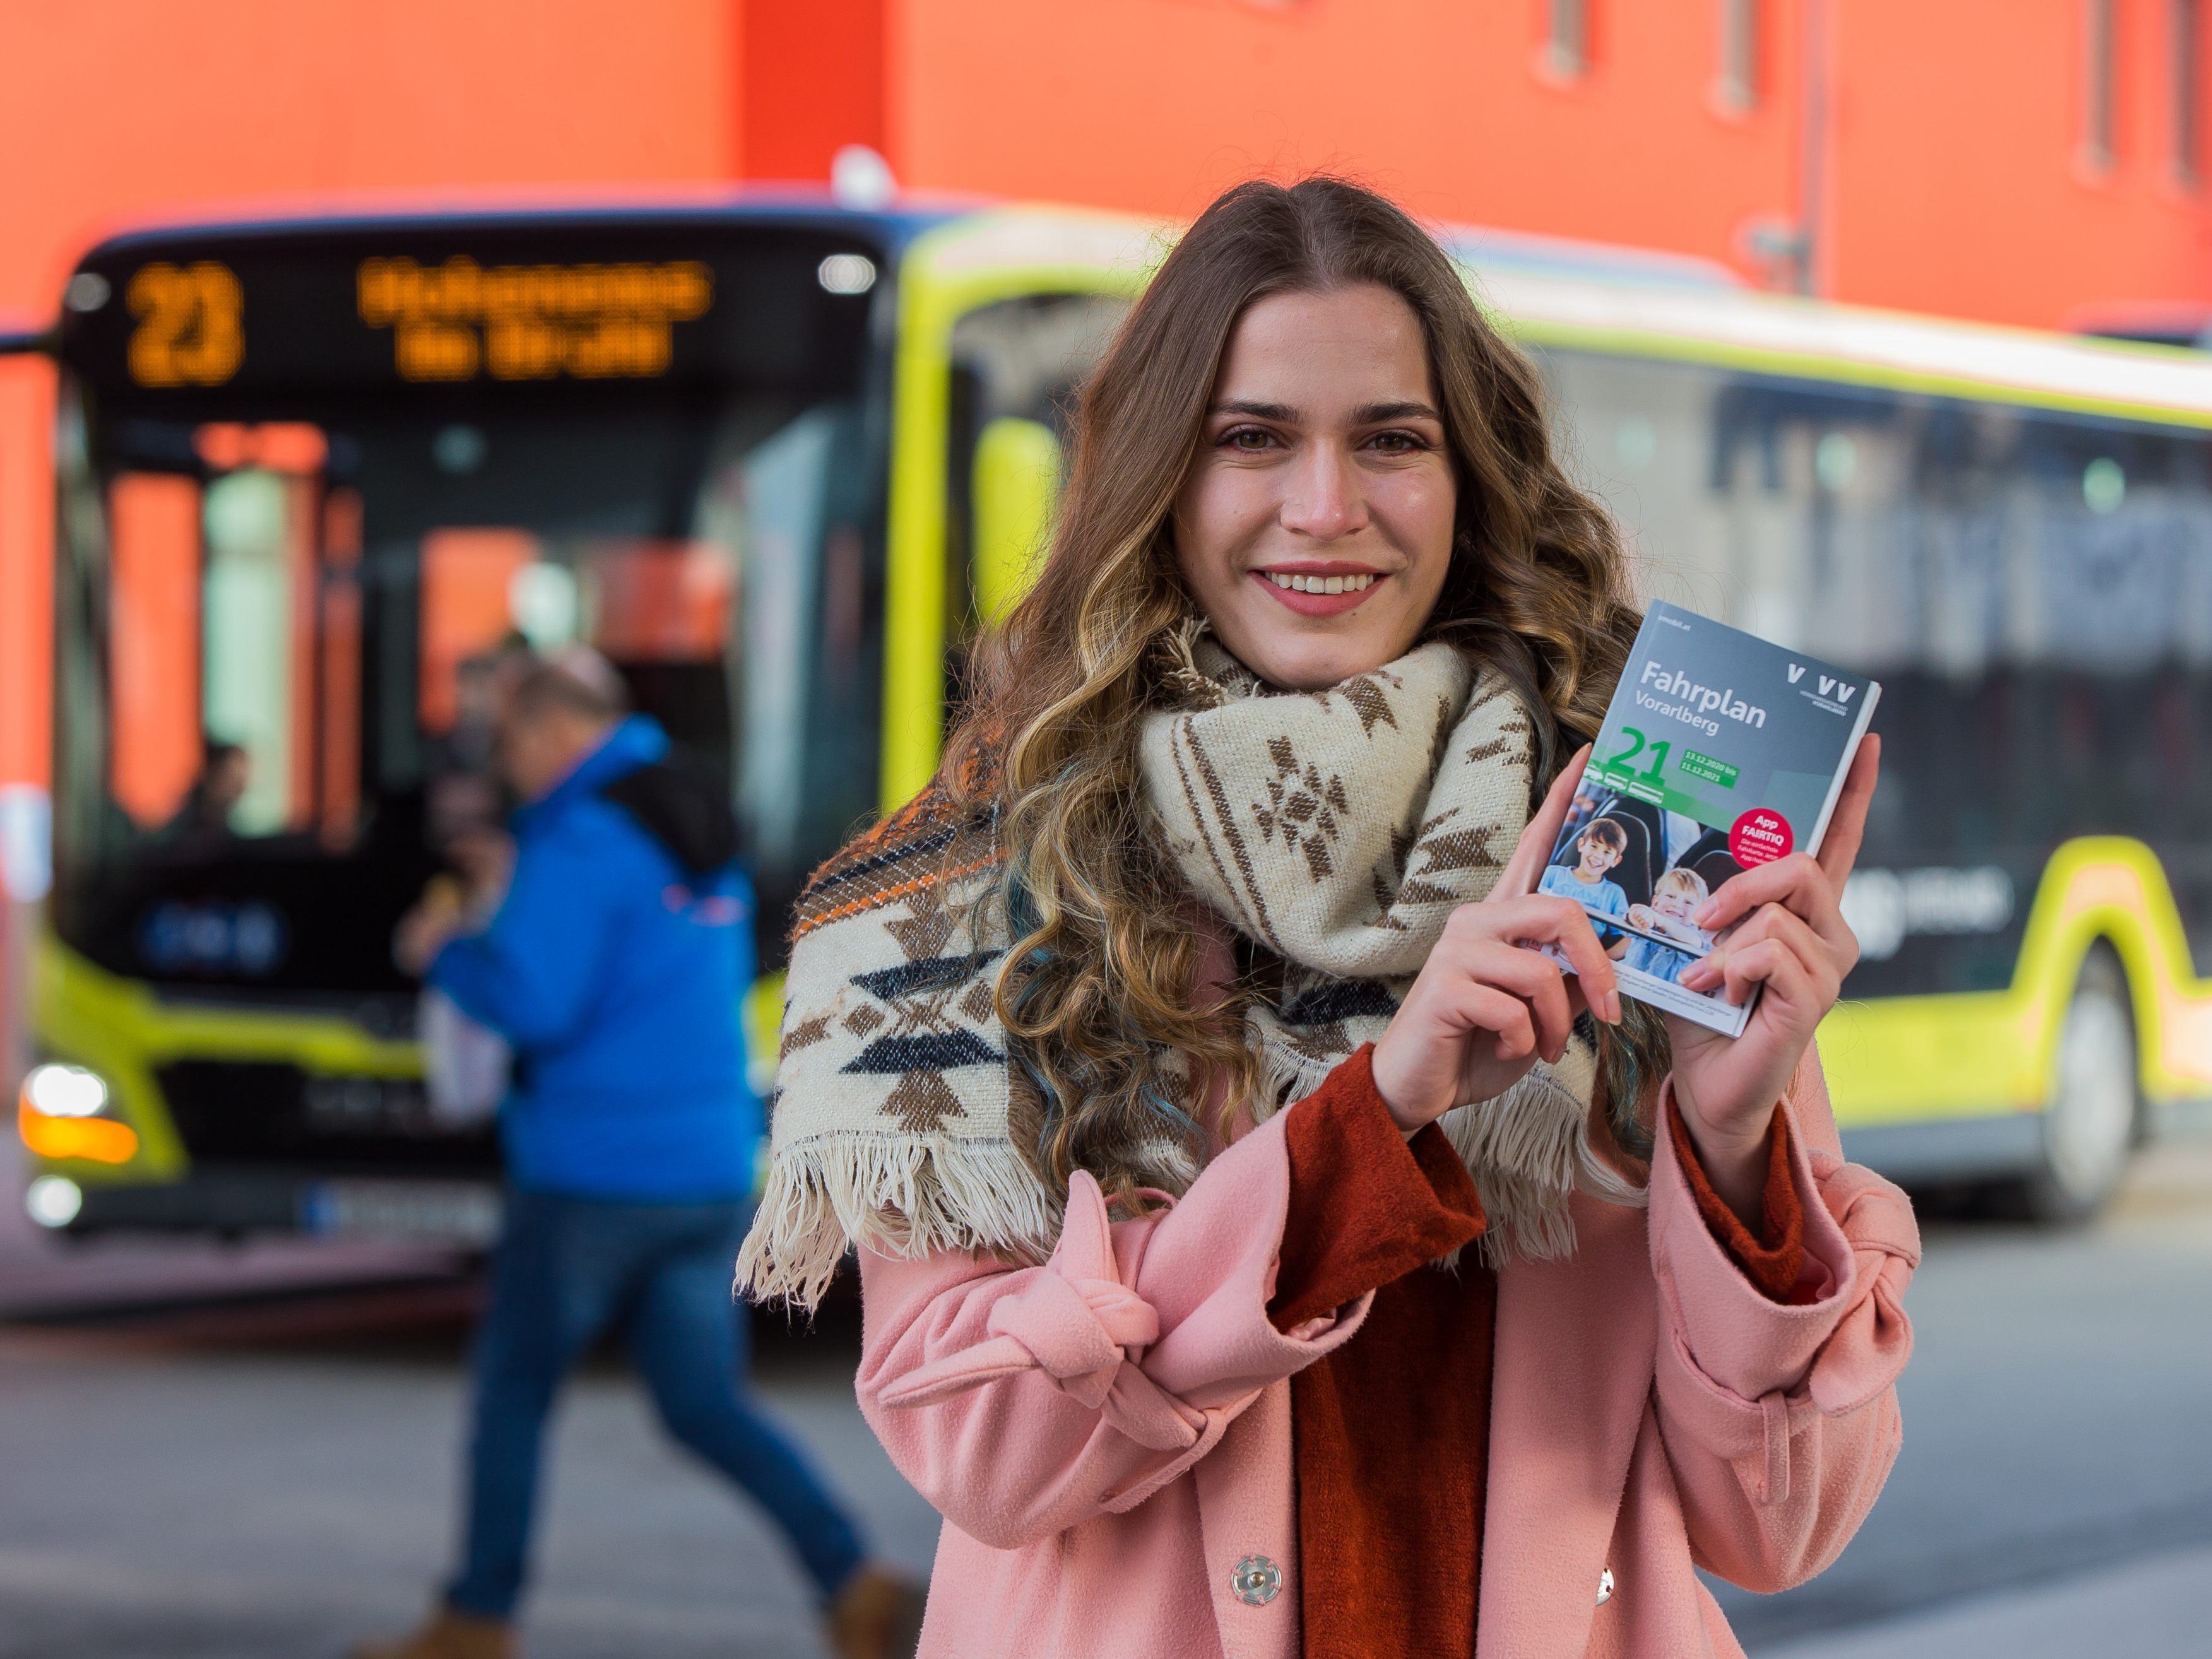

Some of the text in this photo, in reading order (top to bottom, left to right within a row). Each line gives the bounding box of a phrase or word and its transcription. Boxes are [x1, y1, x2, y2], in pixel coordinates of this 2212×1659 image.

[1641, 661, 1767, 729] Fahrplan
[1636, 690, 1720, 737] Vorarlberg
[1608, 726, 1671, 787] 21
[1685, 751, 1737, 776] 13.12.2020 bis
[1681, 762, 1721, 782] 11.12.2021
[1754, 815, 1778, 830] App
[1742, 825, 1784, 847] FAIRTIQ
